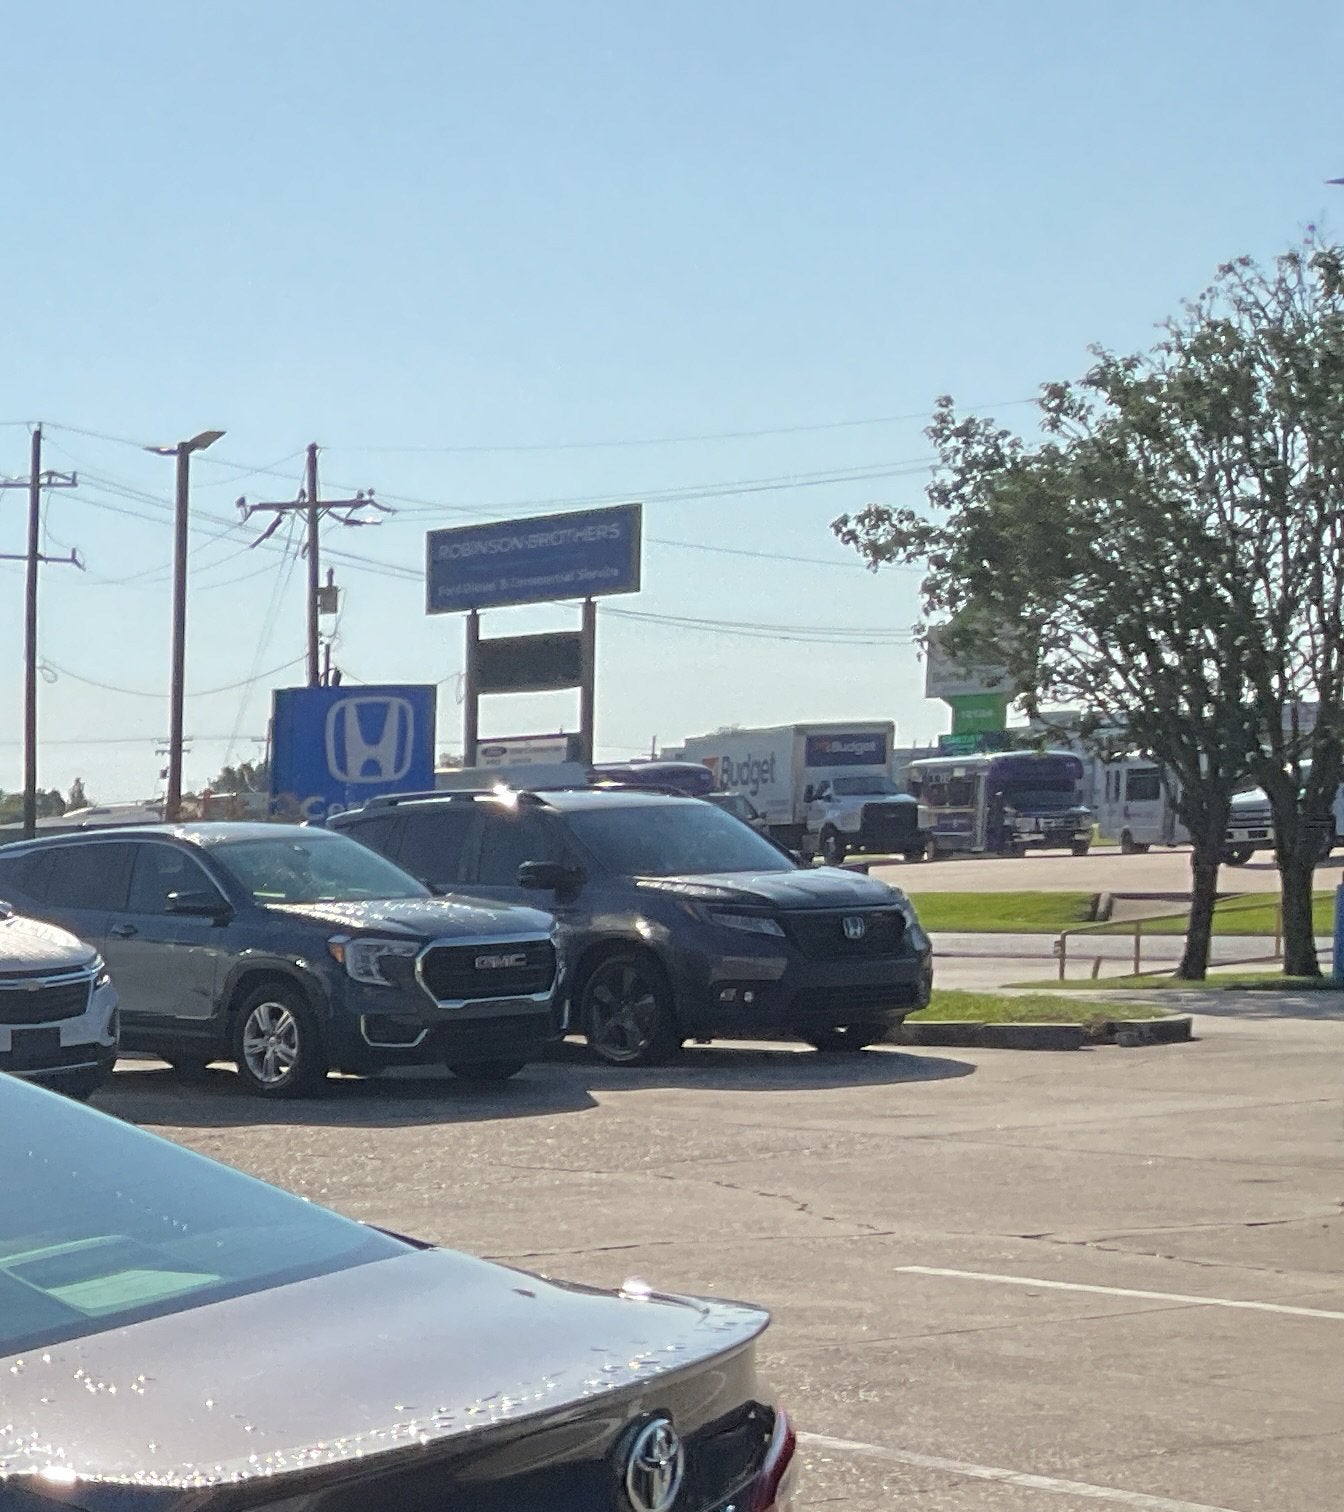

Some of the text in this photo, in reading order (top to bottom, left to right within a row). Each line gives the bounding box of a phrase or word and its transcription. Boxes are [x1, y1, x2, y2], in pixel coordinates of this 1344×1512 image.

[831, 740, 877, 756] Budget
[720, 752, 776, 796] Budget
[475, 953, 527, 970] GMC
